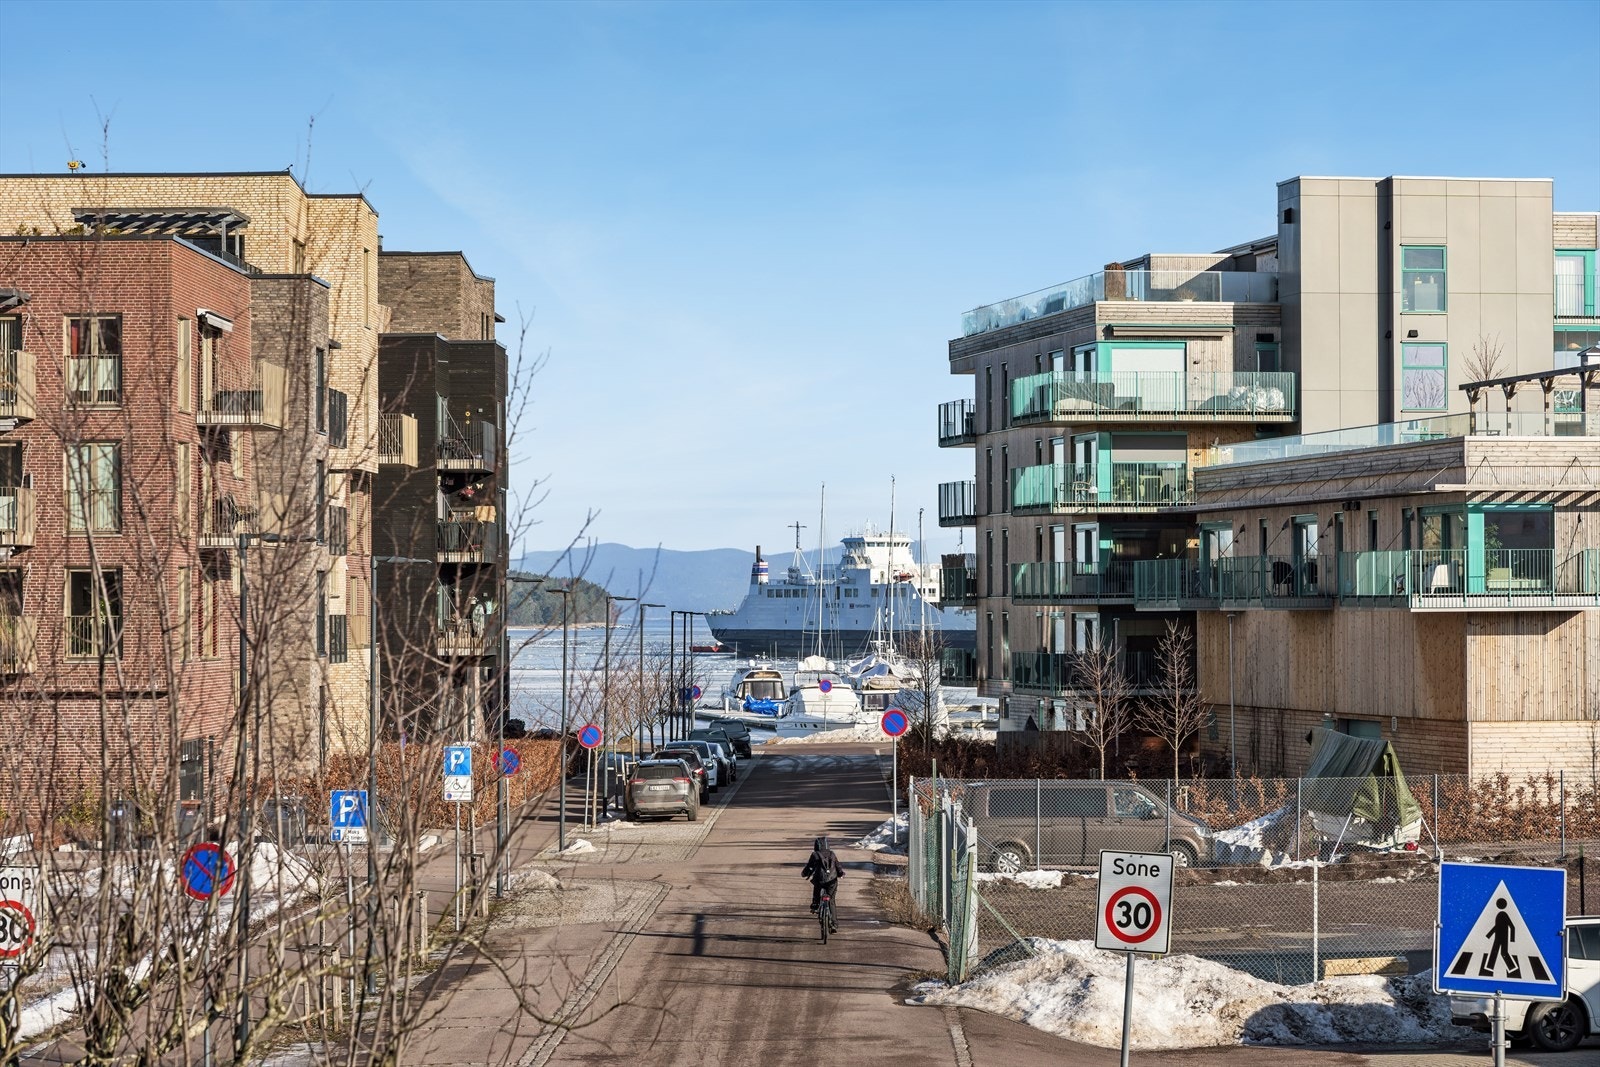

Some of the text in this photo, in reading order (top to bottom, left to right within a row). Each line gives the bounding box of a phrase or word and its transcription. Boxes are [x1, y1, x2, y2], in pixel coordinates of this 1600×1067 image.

[450, 750, 465, 772] P
[340, 795, 358, 823] P
[1112, 857, 1160, 878] Sone
[0, 876, 32, 891] one
[1116, 900, 1152, 930] 30
